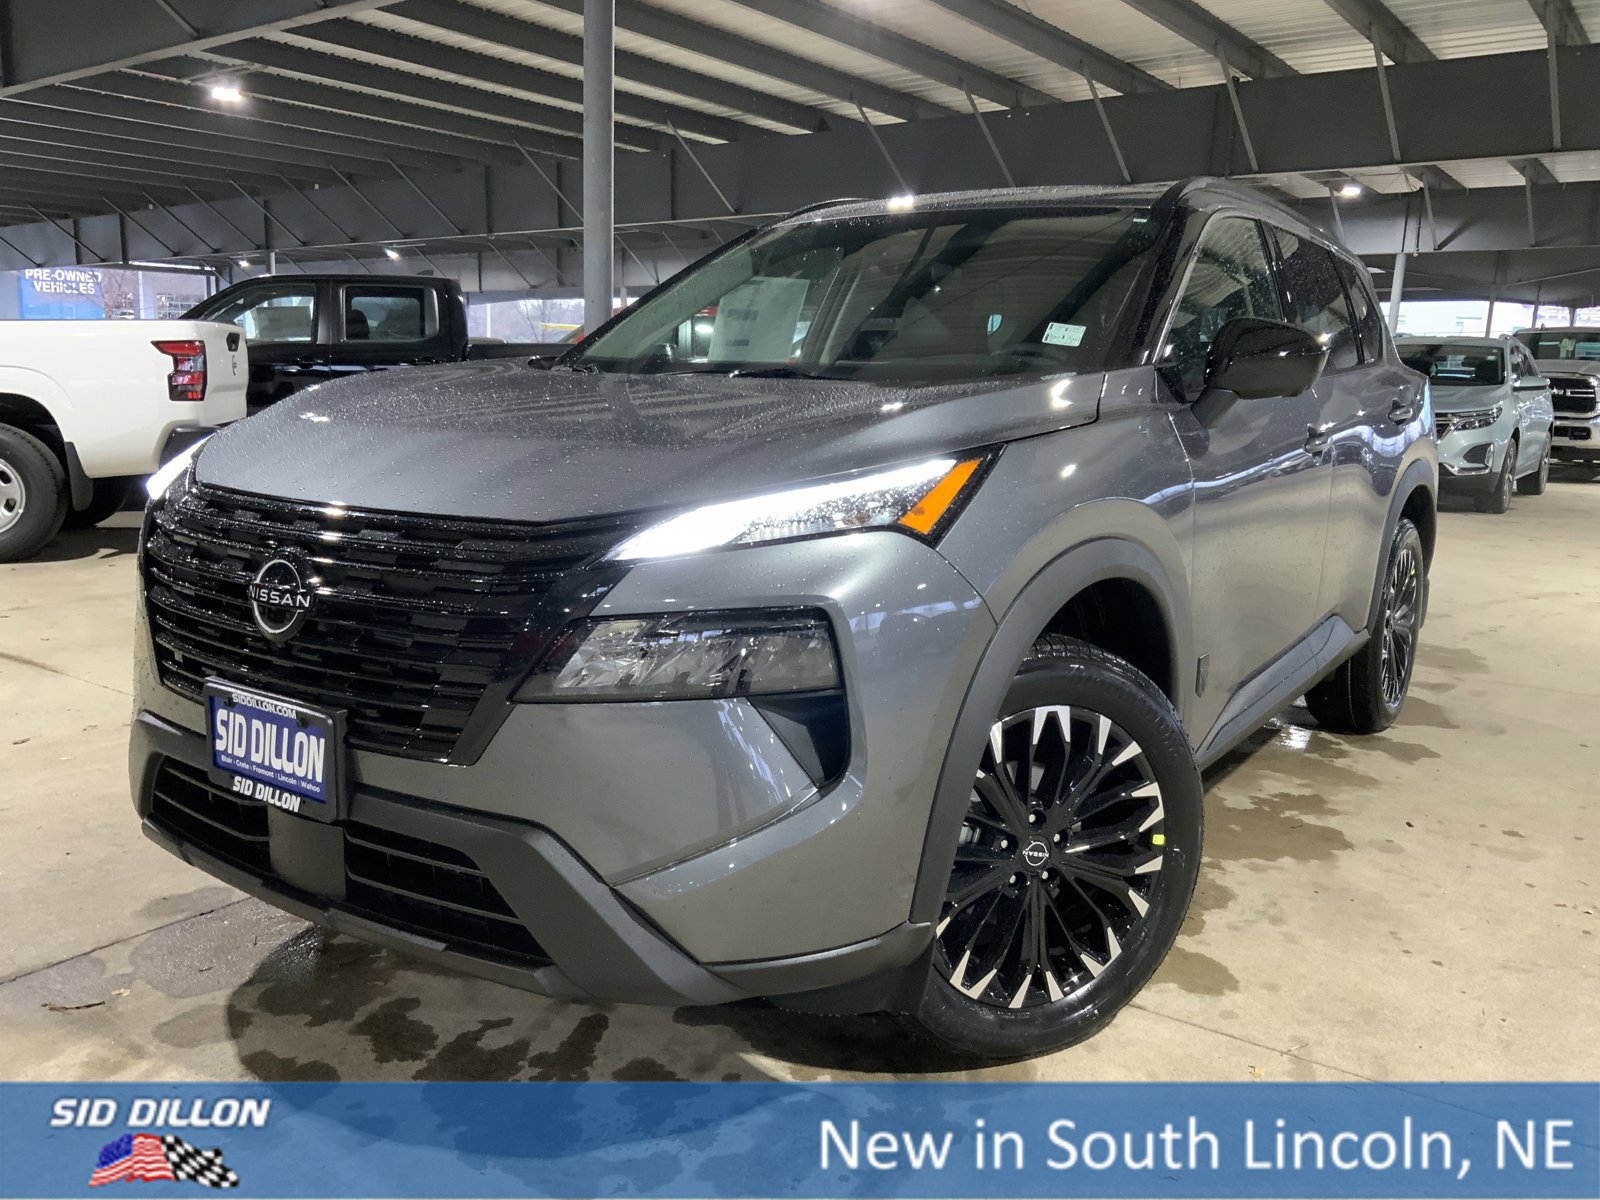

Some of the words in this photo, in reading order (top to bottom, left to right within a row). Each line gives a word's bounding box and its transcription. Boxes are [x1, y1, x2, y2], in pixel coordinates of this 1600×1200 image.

[24, 268, 102, 283] PRE-OWNED
[33, 280, 96, 295] VEHICLES
[249, 585, 311, 608] NISSAN
[231, 693, 297, 720] SIDDILLON.COM
[215, 708, 247, 758] SID
[250, 718, 326, 783] DILLON
[277, 773, 297, 786] Lincoln
[232, 776, 254, 796] SID
[254, 783, 301, 813] DILLON
